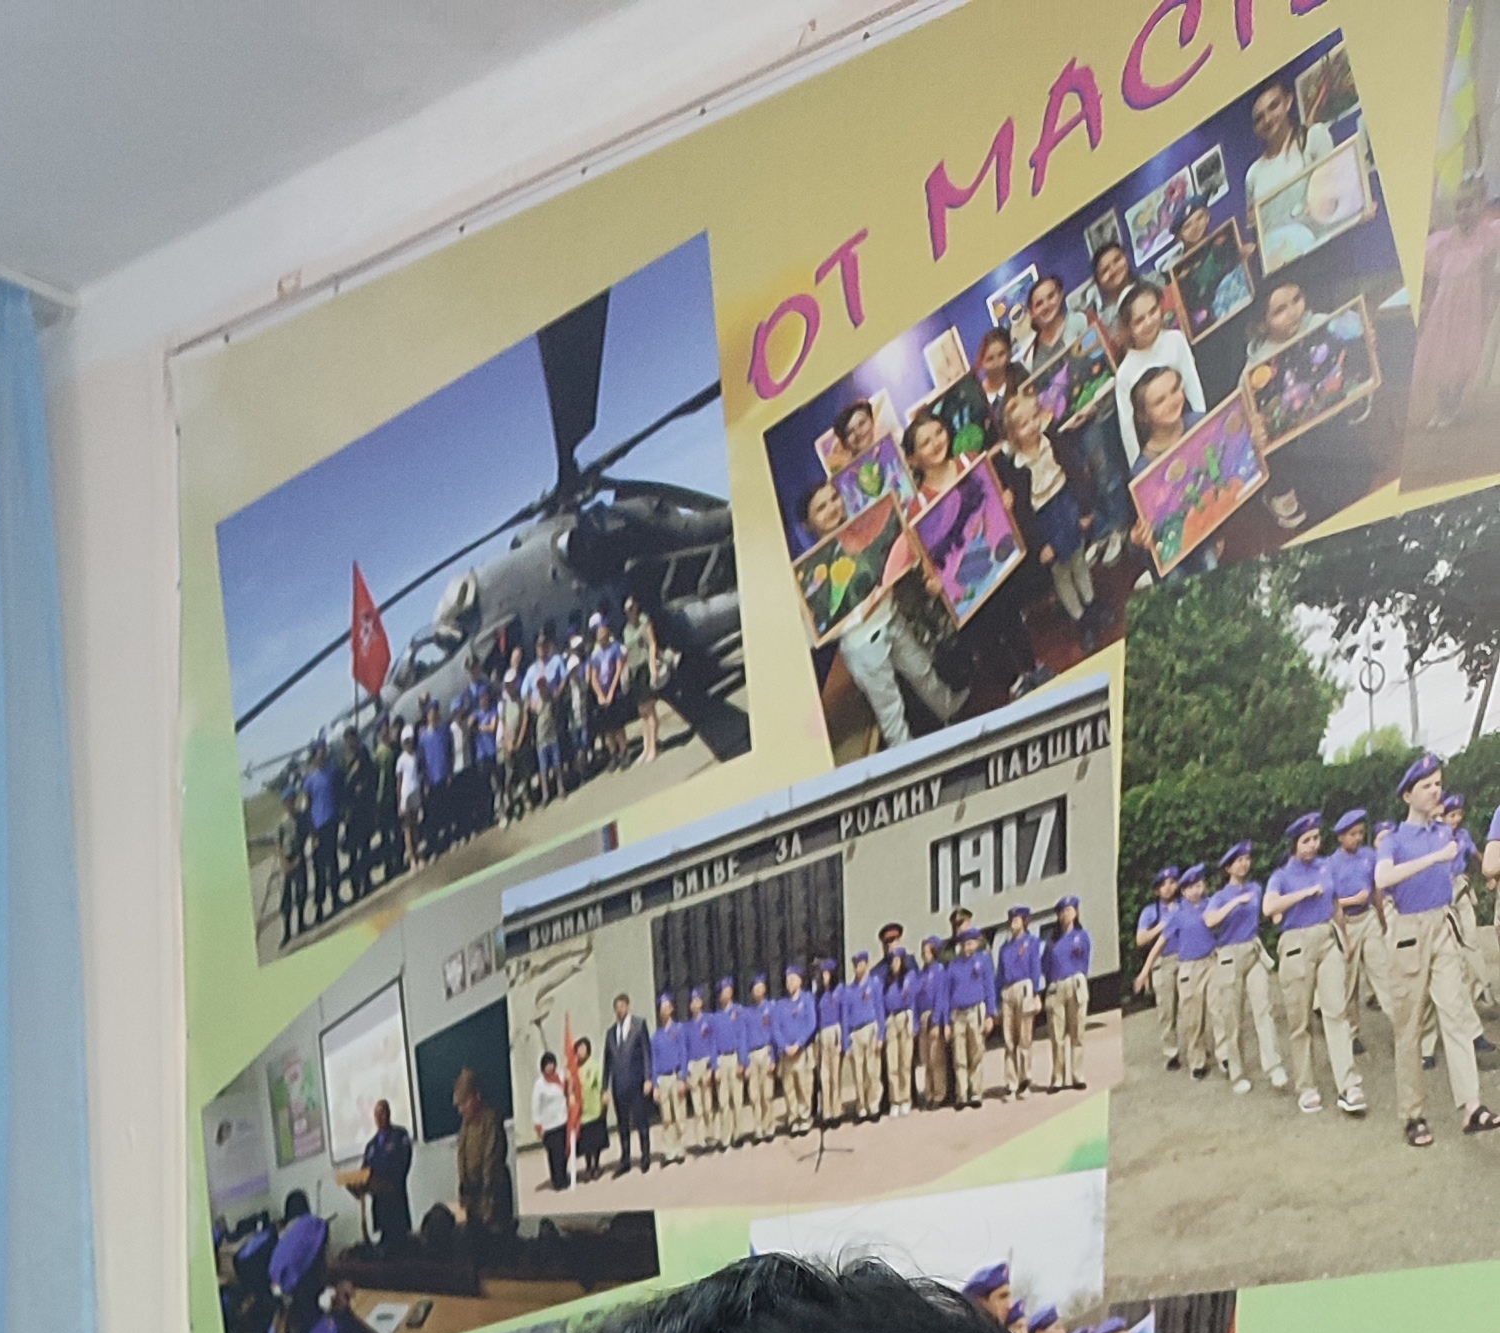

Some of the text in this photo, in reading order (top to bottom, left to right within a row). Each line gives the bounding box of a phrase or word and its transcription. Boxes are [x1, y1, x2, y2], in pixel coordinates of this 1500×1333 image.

[748, 0, 1330, 400] ОТ МАС
[775, 831, 803, 865] ЗА
[839, 777, 942, 841] РОДИНУ
[938, 800, 1058, 914] 1917
